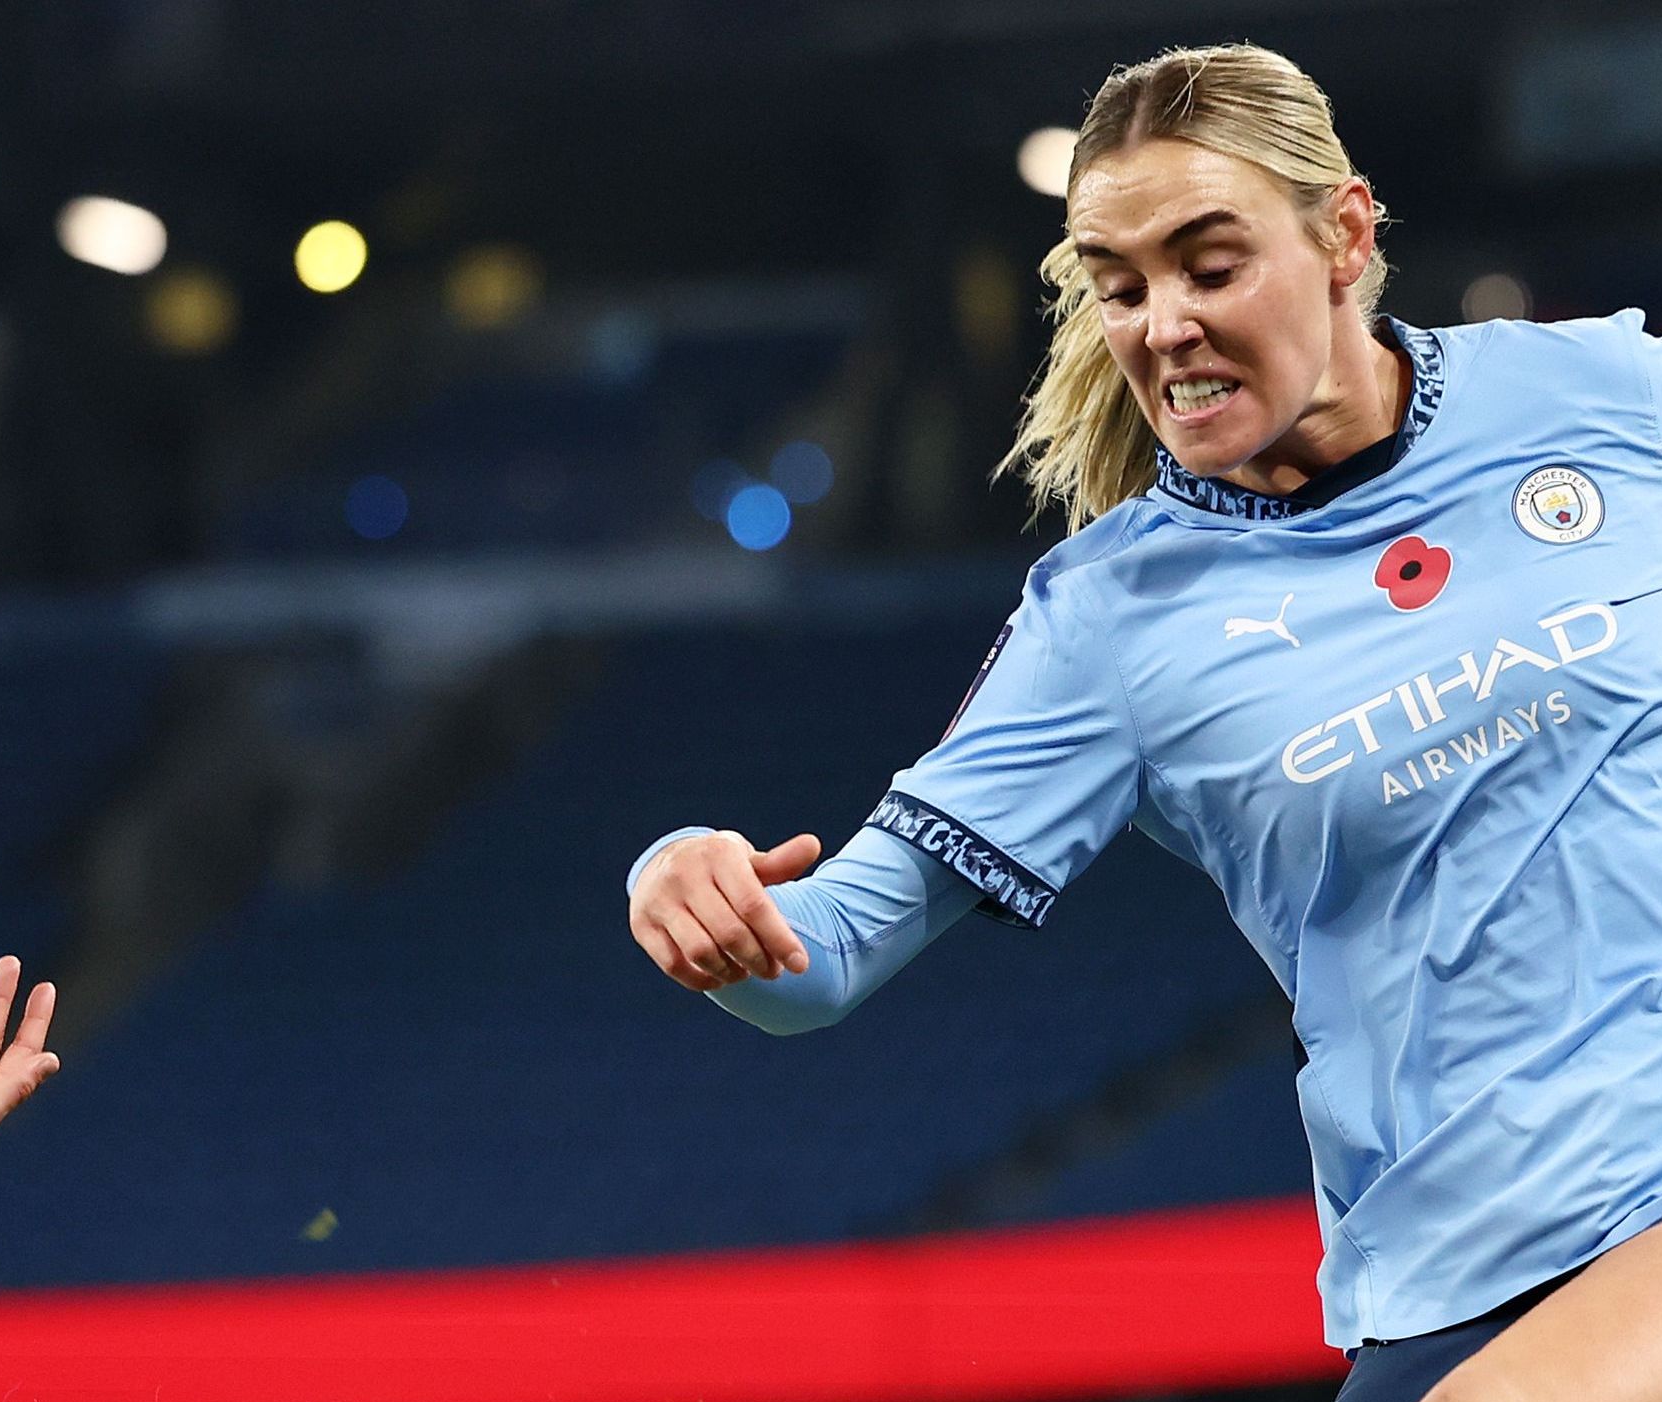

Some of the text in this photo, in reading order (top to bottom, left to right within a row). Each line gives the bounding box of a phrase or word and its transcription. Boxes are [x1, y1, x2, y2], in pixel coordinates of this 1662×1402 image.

[1520, 471, 1587, 506] MANCHESTER
[1559, 529, 1583, 541] CITY
[1281, 603, 1618, 784] ETIHAD
[1381, 690, 1571, 805] AIRWAYS
